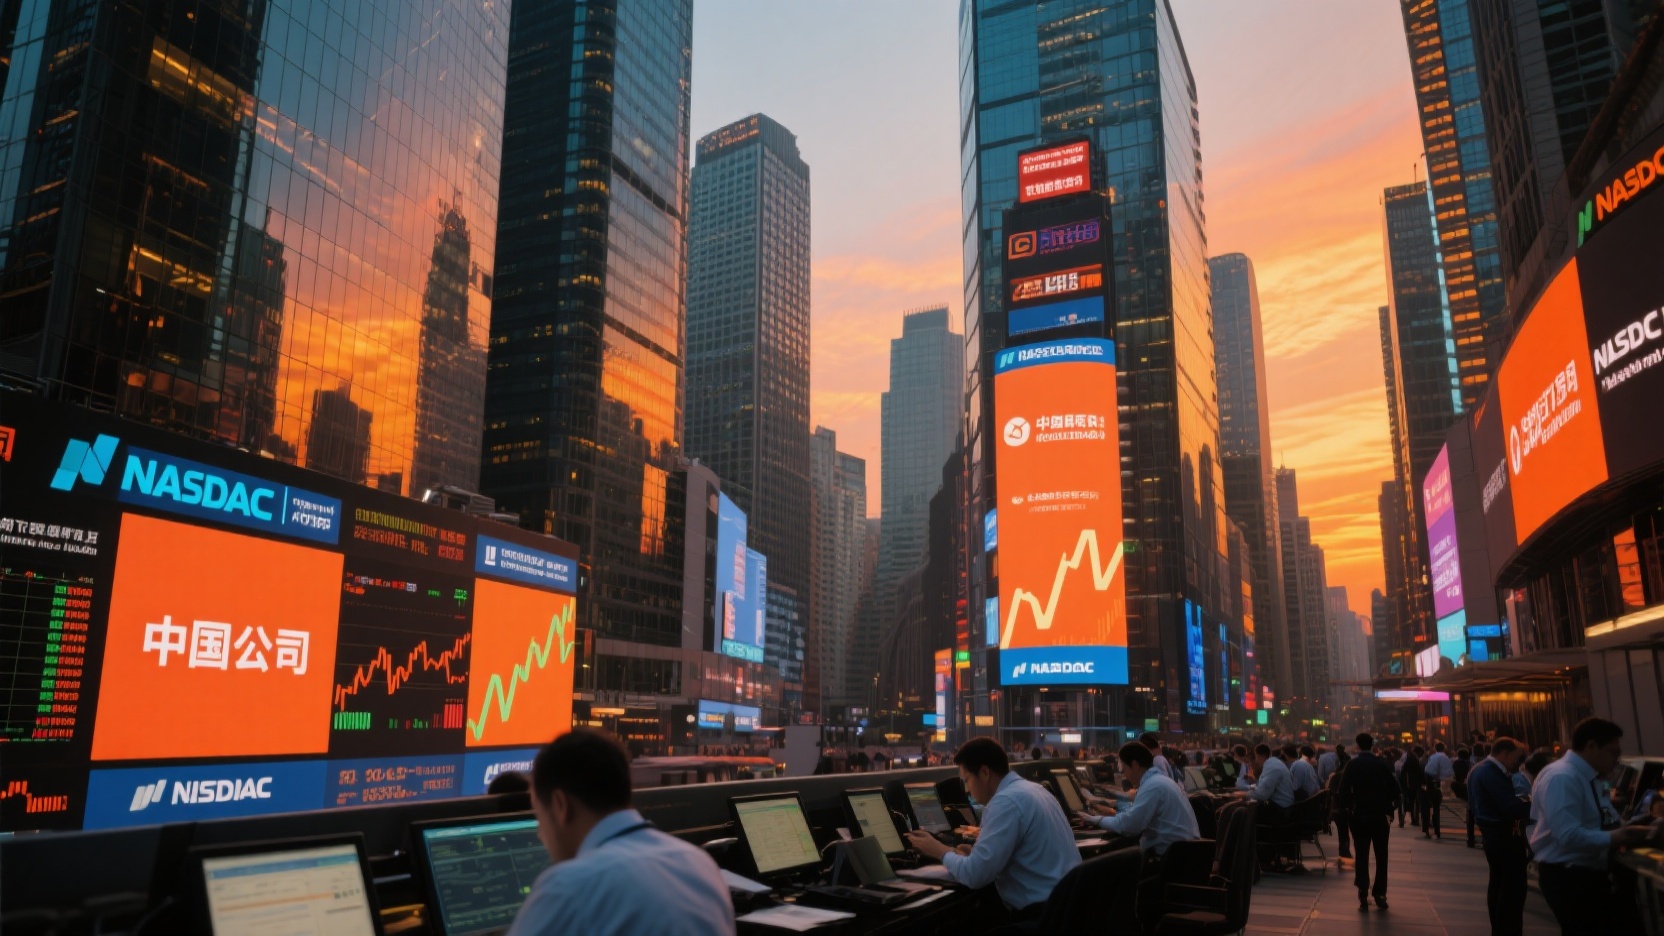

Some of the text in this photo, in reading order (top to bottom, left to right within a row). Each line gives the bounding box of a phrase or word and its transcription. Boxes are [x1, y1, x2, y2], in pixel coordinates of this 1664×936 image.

[121, 455, 274, 520] NASDAC
[143, 615, 309, 675] 中国公司
[171, 777, 272, 804] NISDIAC
